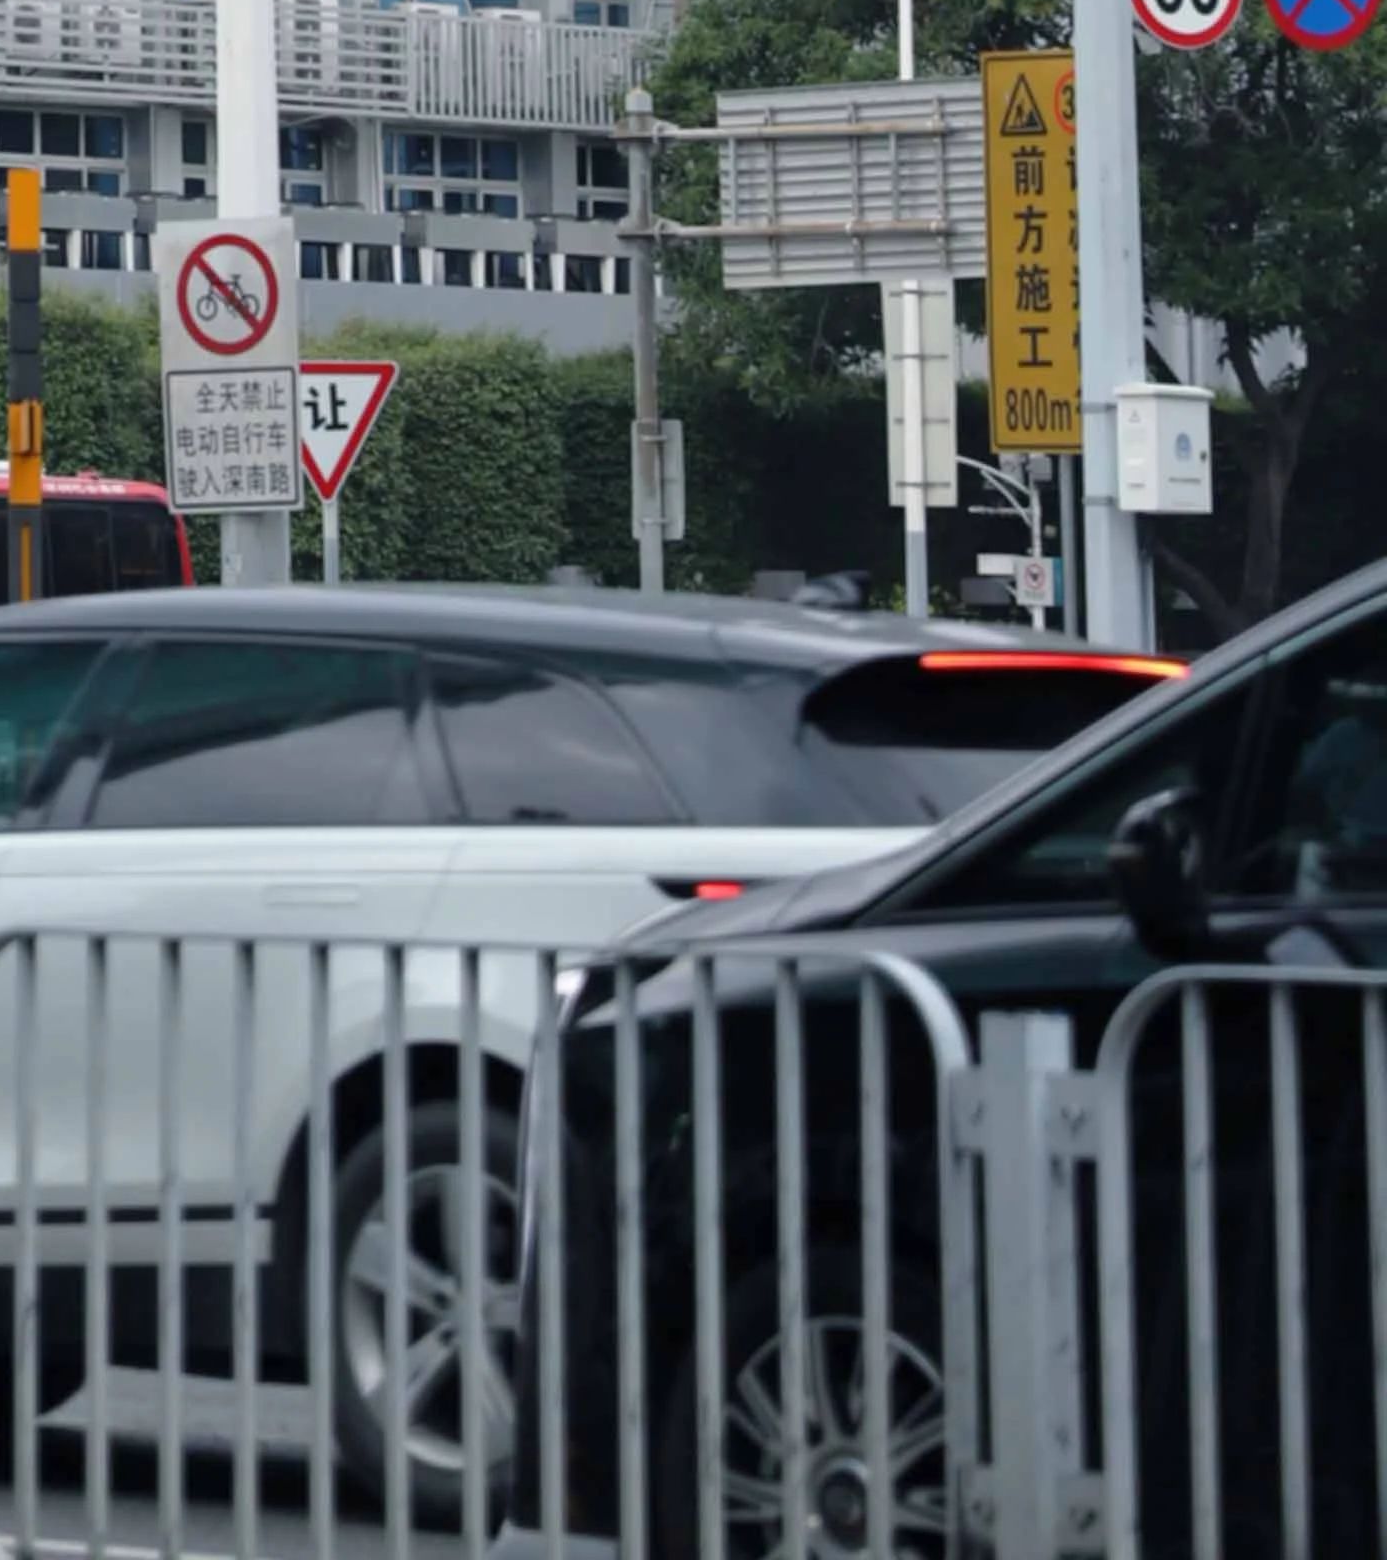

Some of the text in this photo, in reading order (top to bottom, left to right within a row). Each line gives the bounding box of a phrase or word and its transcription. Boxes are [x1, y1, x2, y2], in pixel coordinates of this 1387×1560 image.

[1012, 145, 1052, 368] 前方施工
[195, 380, 287, 413] 全天禁止
[303, 383, 349, 432] 让
[1004, 387, 1072, 432] 800m
[175, 421, 288, 457] 电动自行车
[176, 462, 291, 498] 驶入深南路
